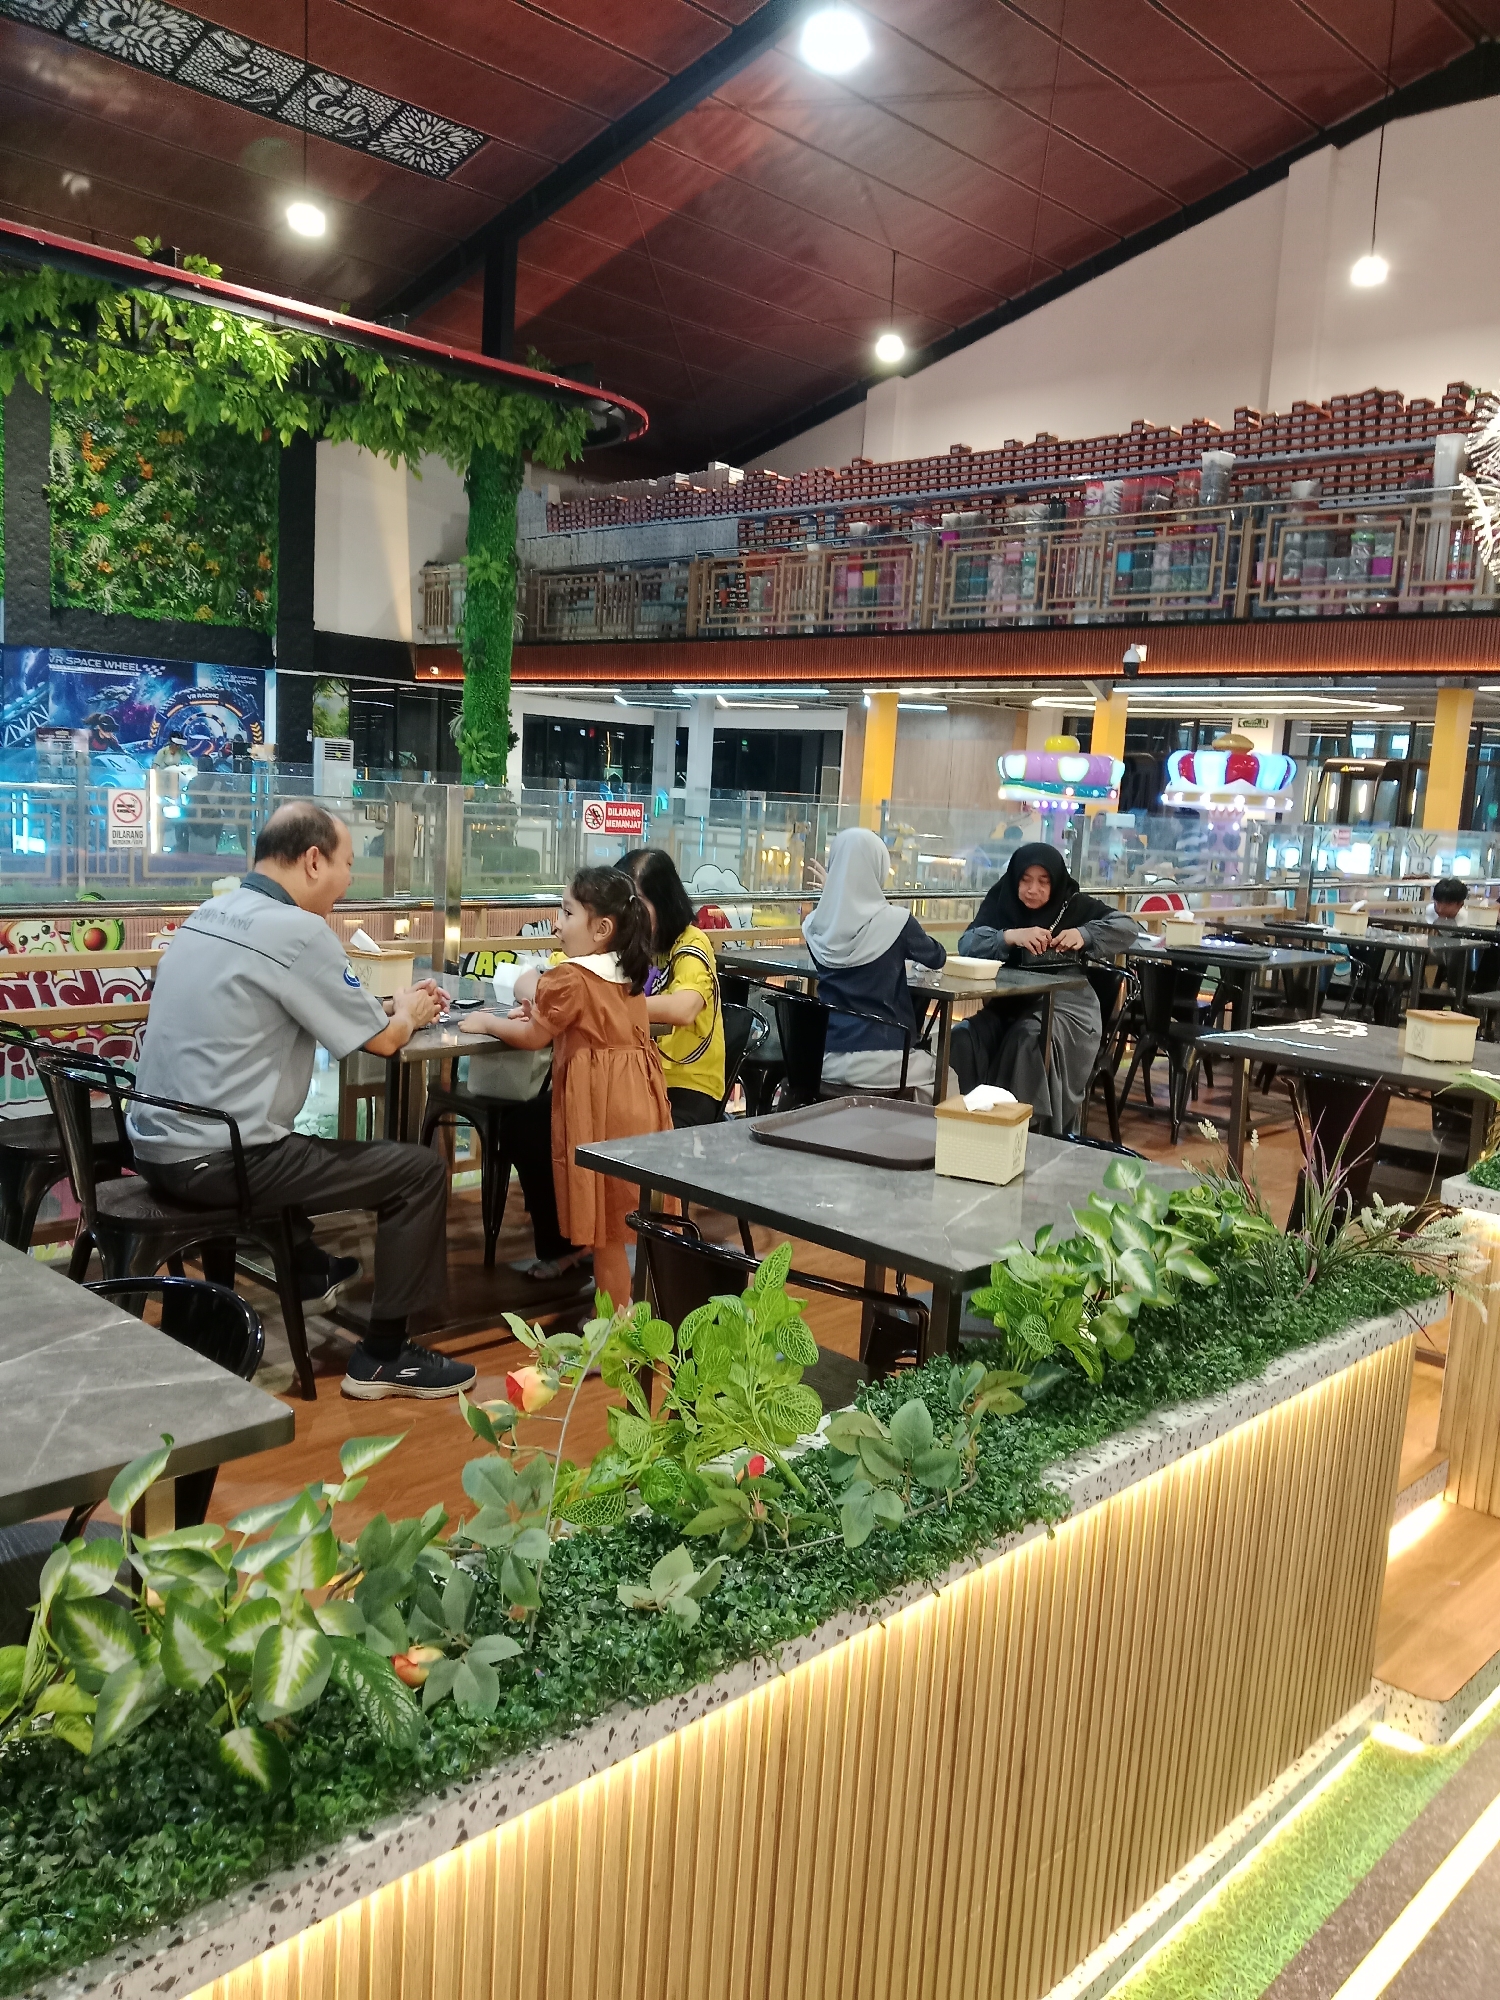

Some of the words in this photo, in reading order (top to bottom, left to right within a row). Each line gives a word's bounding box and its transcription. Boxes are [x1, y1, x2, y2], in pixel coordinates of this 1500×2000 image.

[307, 93, 367, 126] Cali
[49, 655, 64, 664] VR
[65, 656, 102, 668] SPACE
[104, 660, 142, 672] WHEEL
[196, 692, 220, 700] RACING
[607, 807, 641, 818] DILARANG
[605, 819, 642, 829] MEMANJAT
[112, 830, 144, 839] DILARANG
